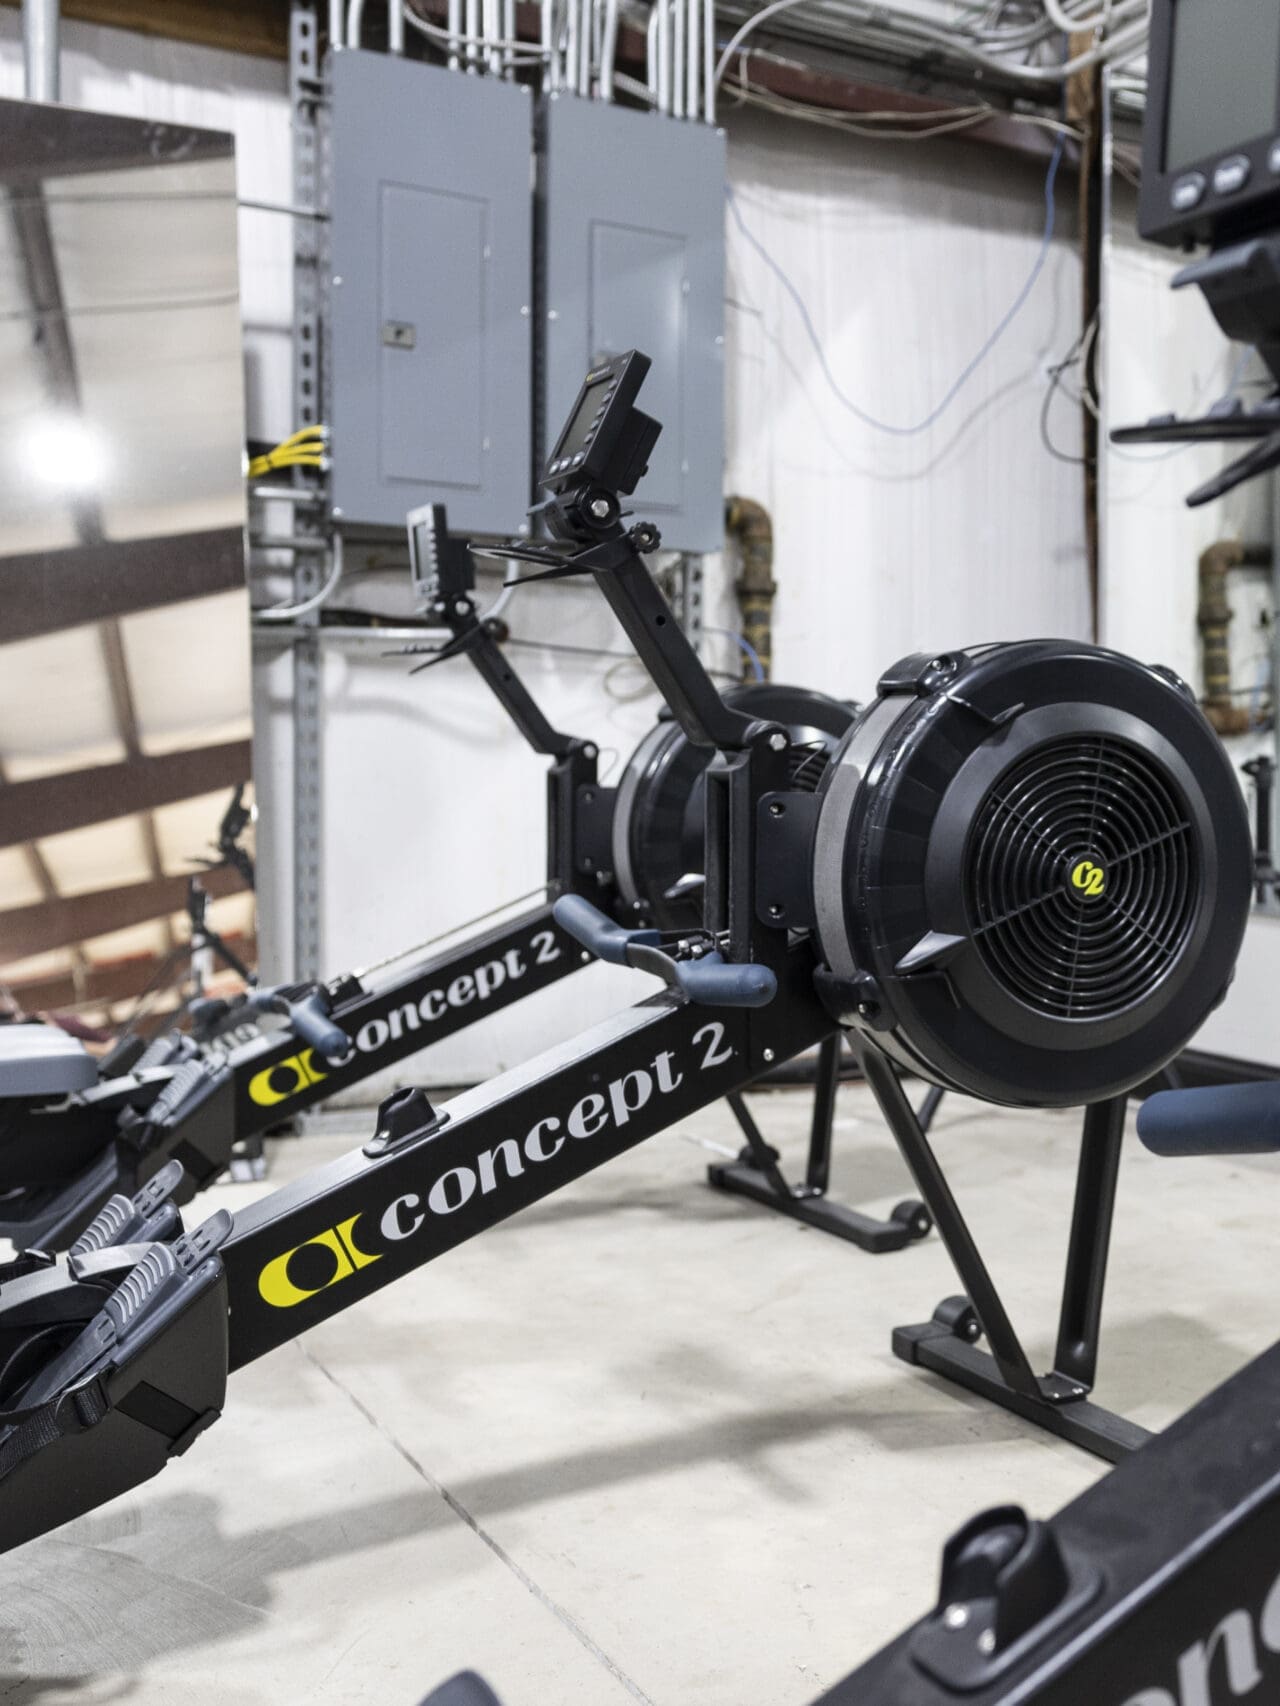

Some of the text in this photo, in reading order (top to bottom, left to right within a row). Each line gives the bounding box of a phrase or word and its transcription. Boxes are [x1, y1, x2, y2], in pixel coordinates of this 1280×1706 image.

[1071, 860, 1105, 896] C2
[530, 930, 561, 964] 2
[380, 1021, 733, 1241] concept 2
